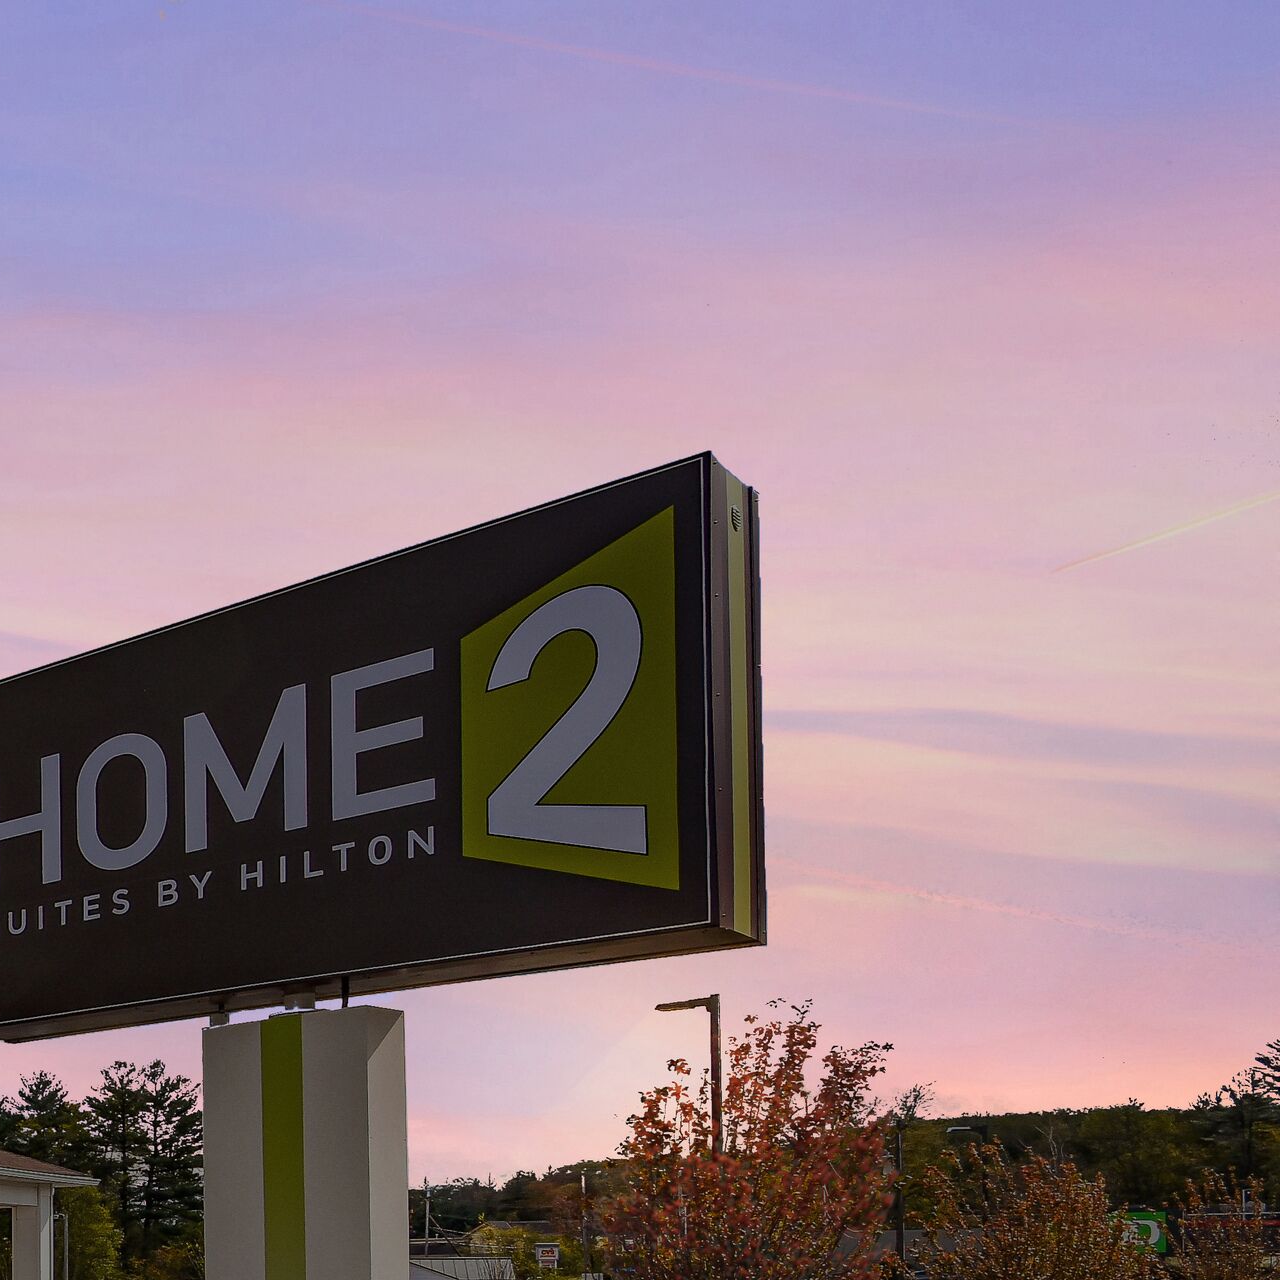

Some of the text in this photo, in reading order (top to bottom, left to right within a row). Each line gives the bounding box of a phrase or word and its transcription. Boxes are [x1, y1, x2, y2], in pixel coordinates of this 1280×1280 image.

[485, 584, 647, 855] 2
[158, 871, 212, 907] BY
[241, 826, 435, 891] HILTON
